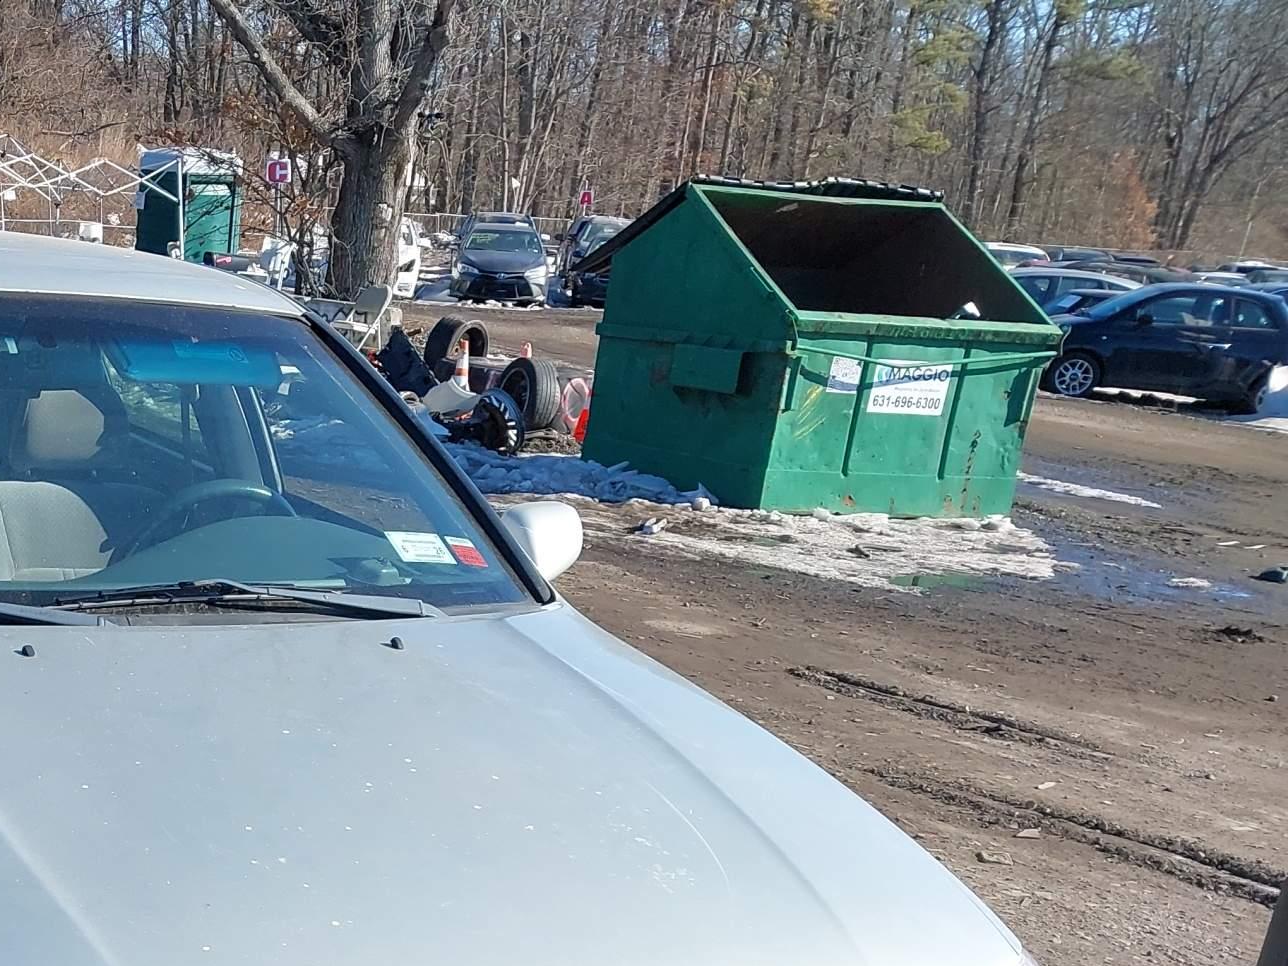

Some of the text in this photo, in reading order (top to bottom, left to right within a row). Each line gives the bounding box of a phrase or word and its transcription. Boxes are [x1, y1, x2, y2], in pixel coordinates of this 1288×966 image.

[268, 161, 289, 182] C
[886, 367, 950, 382] MAGGIO
[872, 394, 941, 410] 631-696-6300
